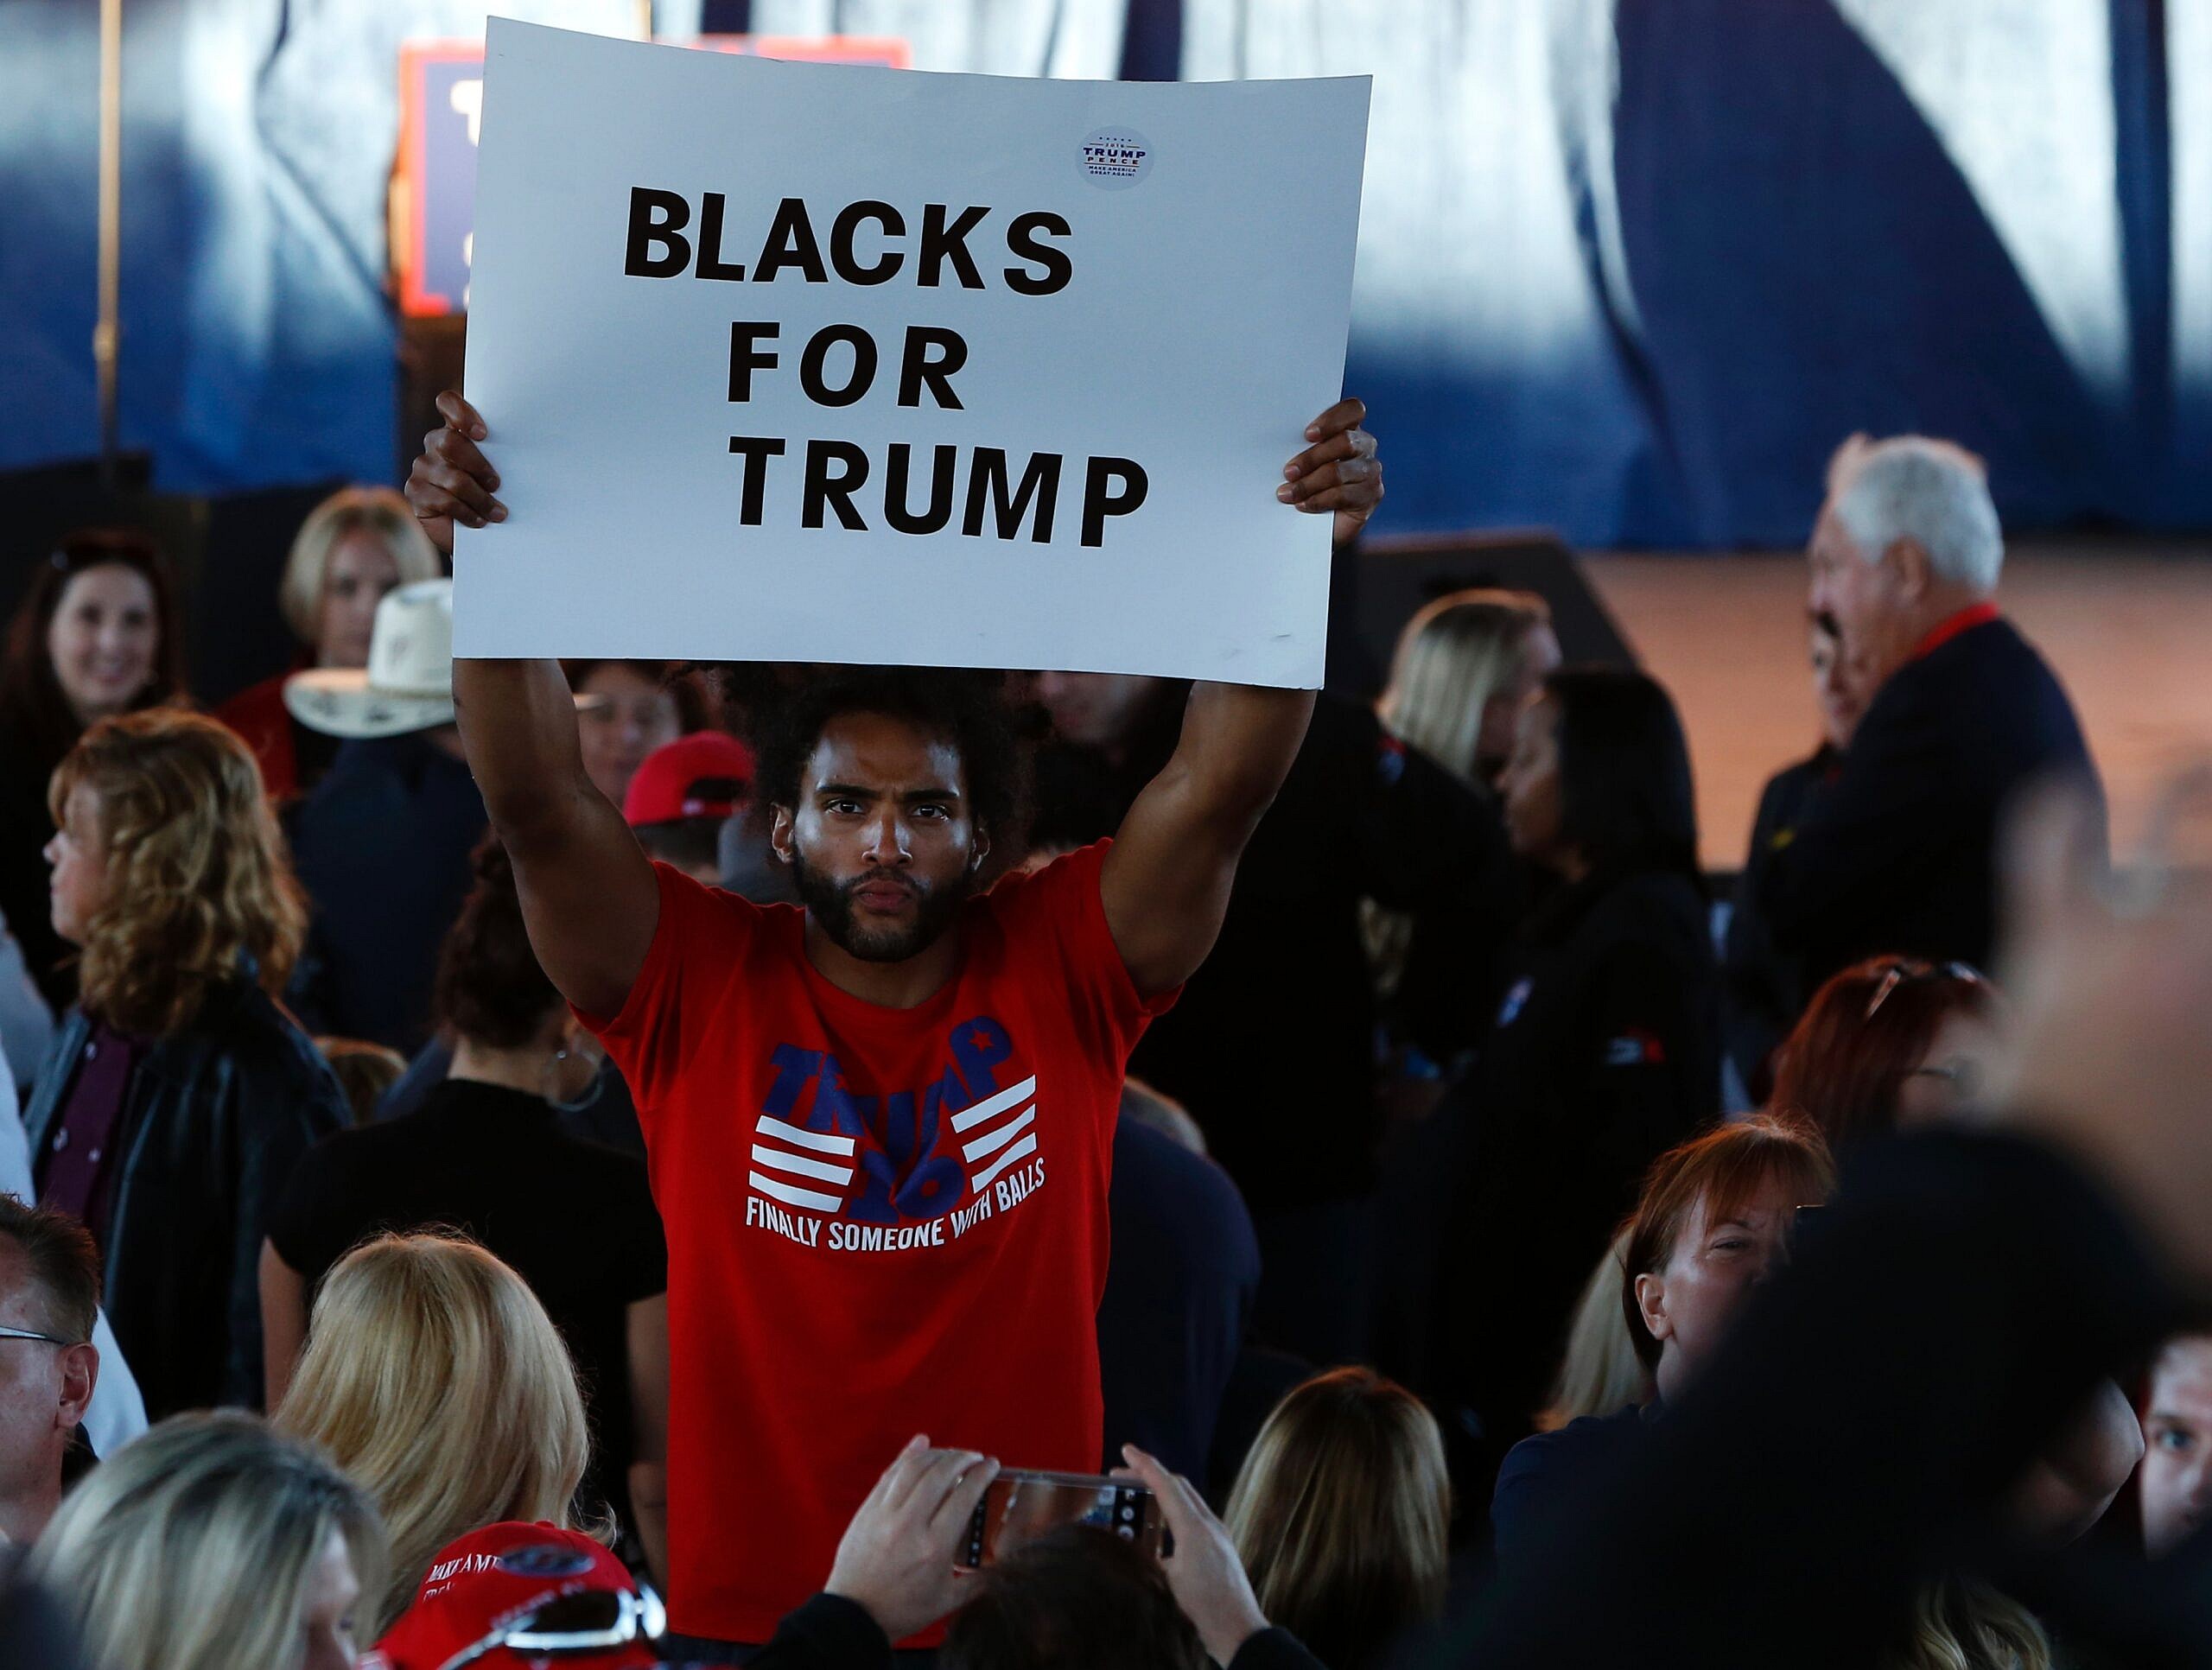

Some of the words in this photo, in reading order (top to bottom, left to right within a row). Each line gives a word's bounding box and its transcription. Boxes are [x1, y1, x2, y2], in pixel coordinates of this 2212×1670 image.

[1083, 147, 1146, 159] TRUMP
[1087, 156, 1139, 165] PENCE
[624, 186, 1073, 296] BLACKS
[728, 321, 969, 410] FOR
[728, 435, 1150, 548] TRUMP
[761, 1015, 1014, 1165] TRUMP
[746, 1196, 823, 1248] FINALLY
[828, 1217, 945, 1252] SOMEONE
[950, 1192, 992, 1239] WITH
[995, 1157, 1046, 1213] BALLS
[846, 1130, 966, 1224] 16
